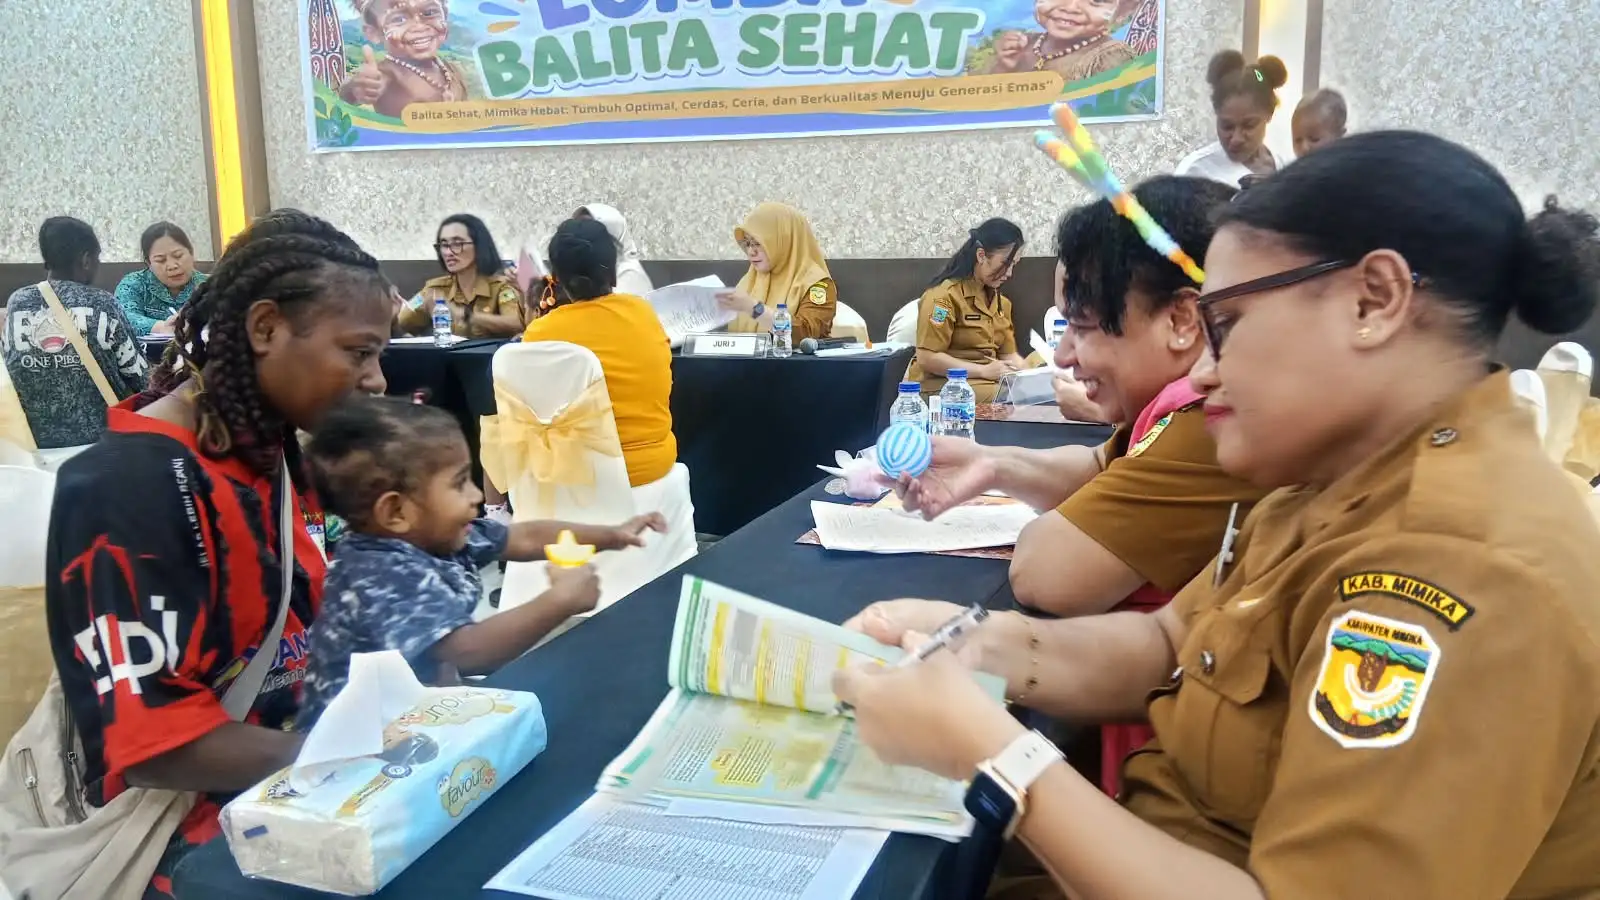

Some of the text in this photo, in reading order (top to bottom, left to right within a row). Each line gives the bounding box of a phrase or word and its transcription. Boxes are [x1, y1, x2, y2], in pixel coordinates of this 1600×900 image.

[477, 12, 980, 99] BALITA SEHAT
[411, 110, 443, 120] Balita
[446, 109, 482, 119] Sehat,
[484, 107, 527, 118] Mimika
[572, 104, 622, 114] Tumbuh
[625, 101, 678, 114] Optimal,
[682, 98, 728, 110] Cerdas,
[732, 96, 768, 108] Ceria,
[772, 95, 797, 106] dan
[800, 91, 878, 105] Berkualitas
[881, 87, 935, 101] Menuju
[939, 82, 1003, 97] Generasi
[21, 354, 82, 369] ONE PIEC
[713, 340, 730, 348] JURI
[1348, 574, 1458, 617] KAB. MIMIKA
[447, 763, 488, 806] favour
